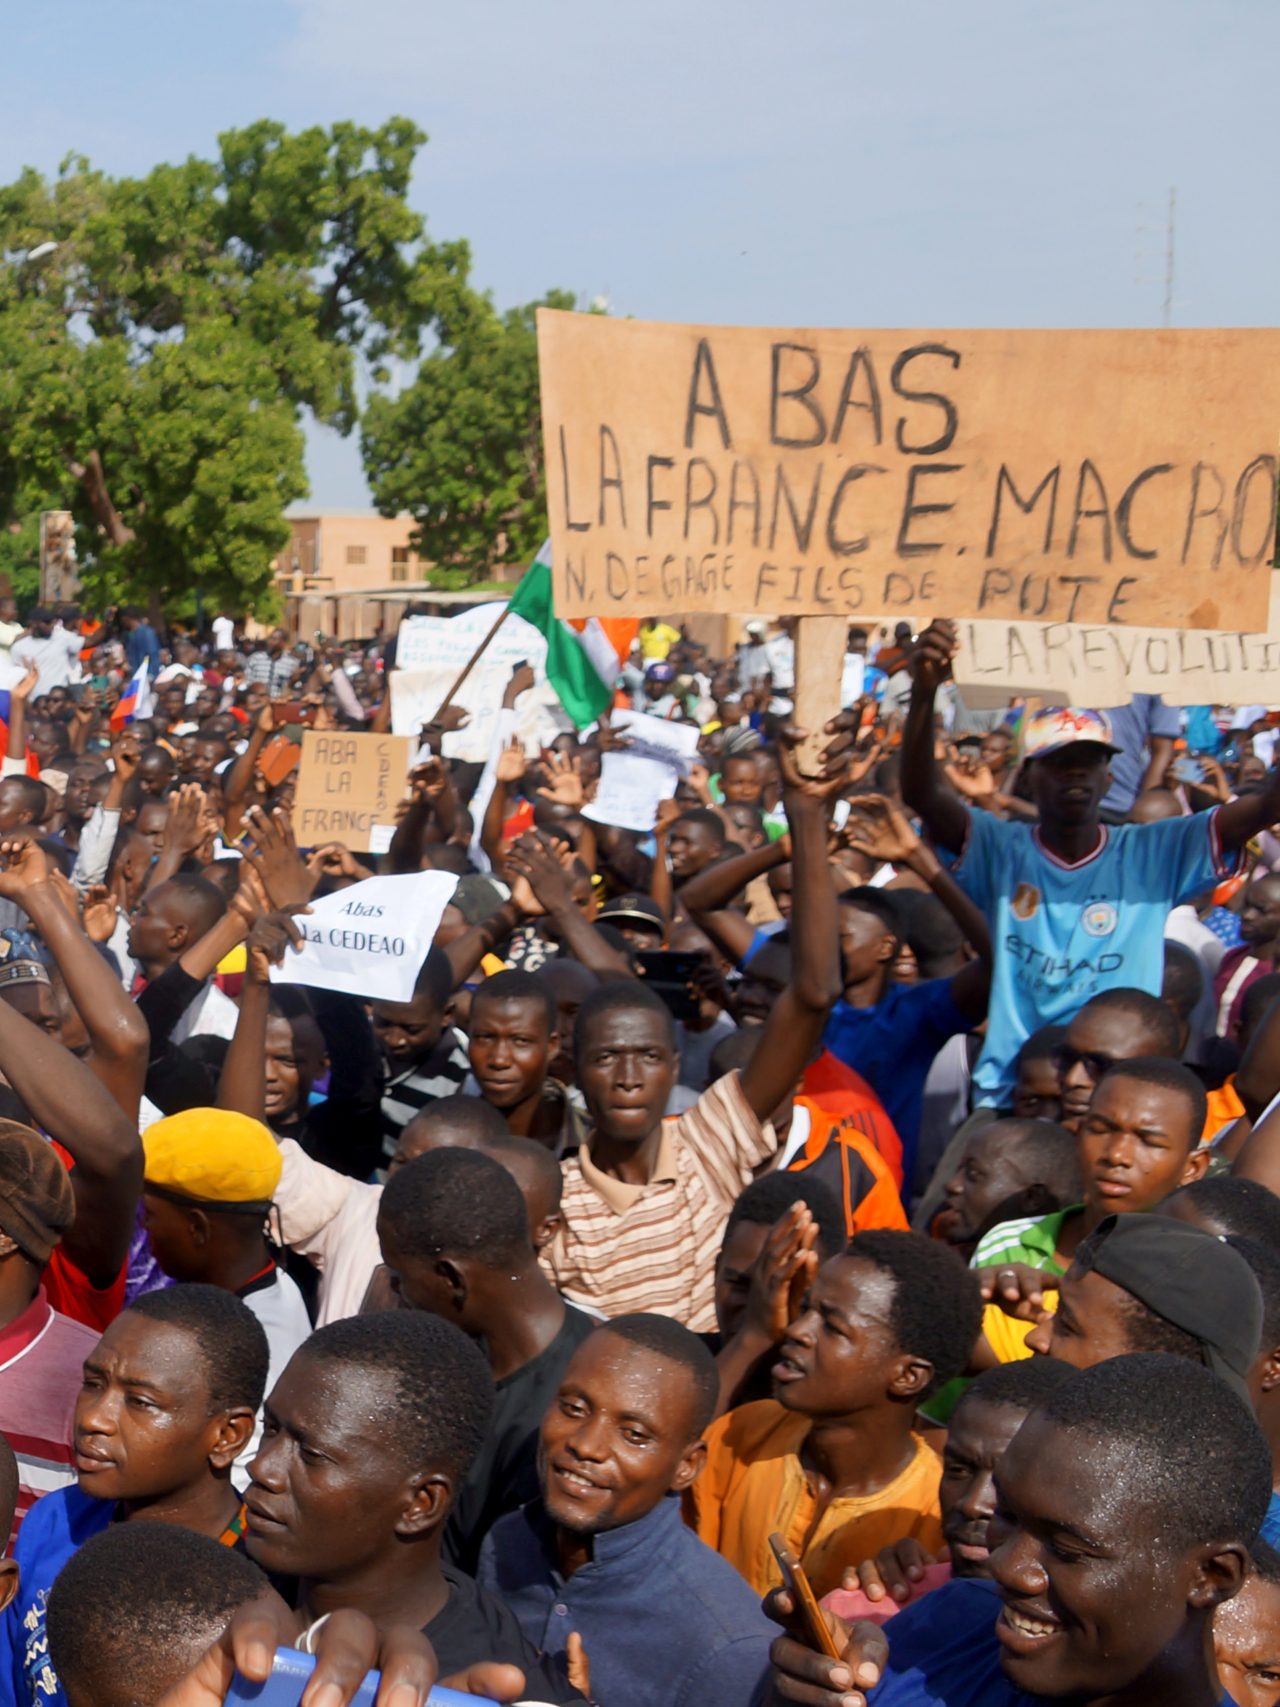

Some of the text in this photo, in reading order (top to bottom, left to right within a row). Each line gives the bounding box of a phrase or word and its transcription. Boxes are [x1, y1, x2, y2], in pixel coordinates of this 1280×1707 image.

[684, 337, 961, 455] A BAS
[559, 423, 627, 532] LA
[883, 570, 937, 607] DE
[978, 567, 1138, 623] PUTE
[325, 770, 352, 793] LA
[338, 901, 385, 917] Abas
[329, 928, 404, 957] CEDEAO
[1005, 935, 1124, 976] ETIHAD
